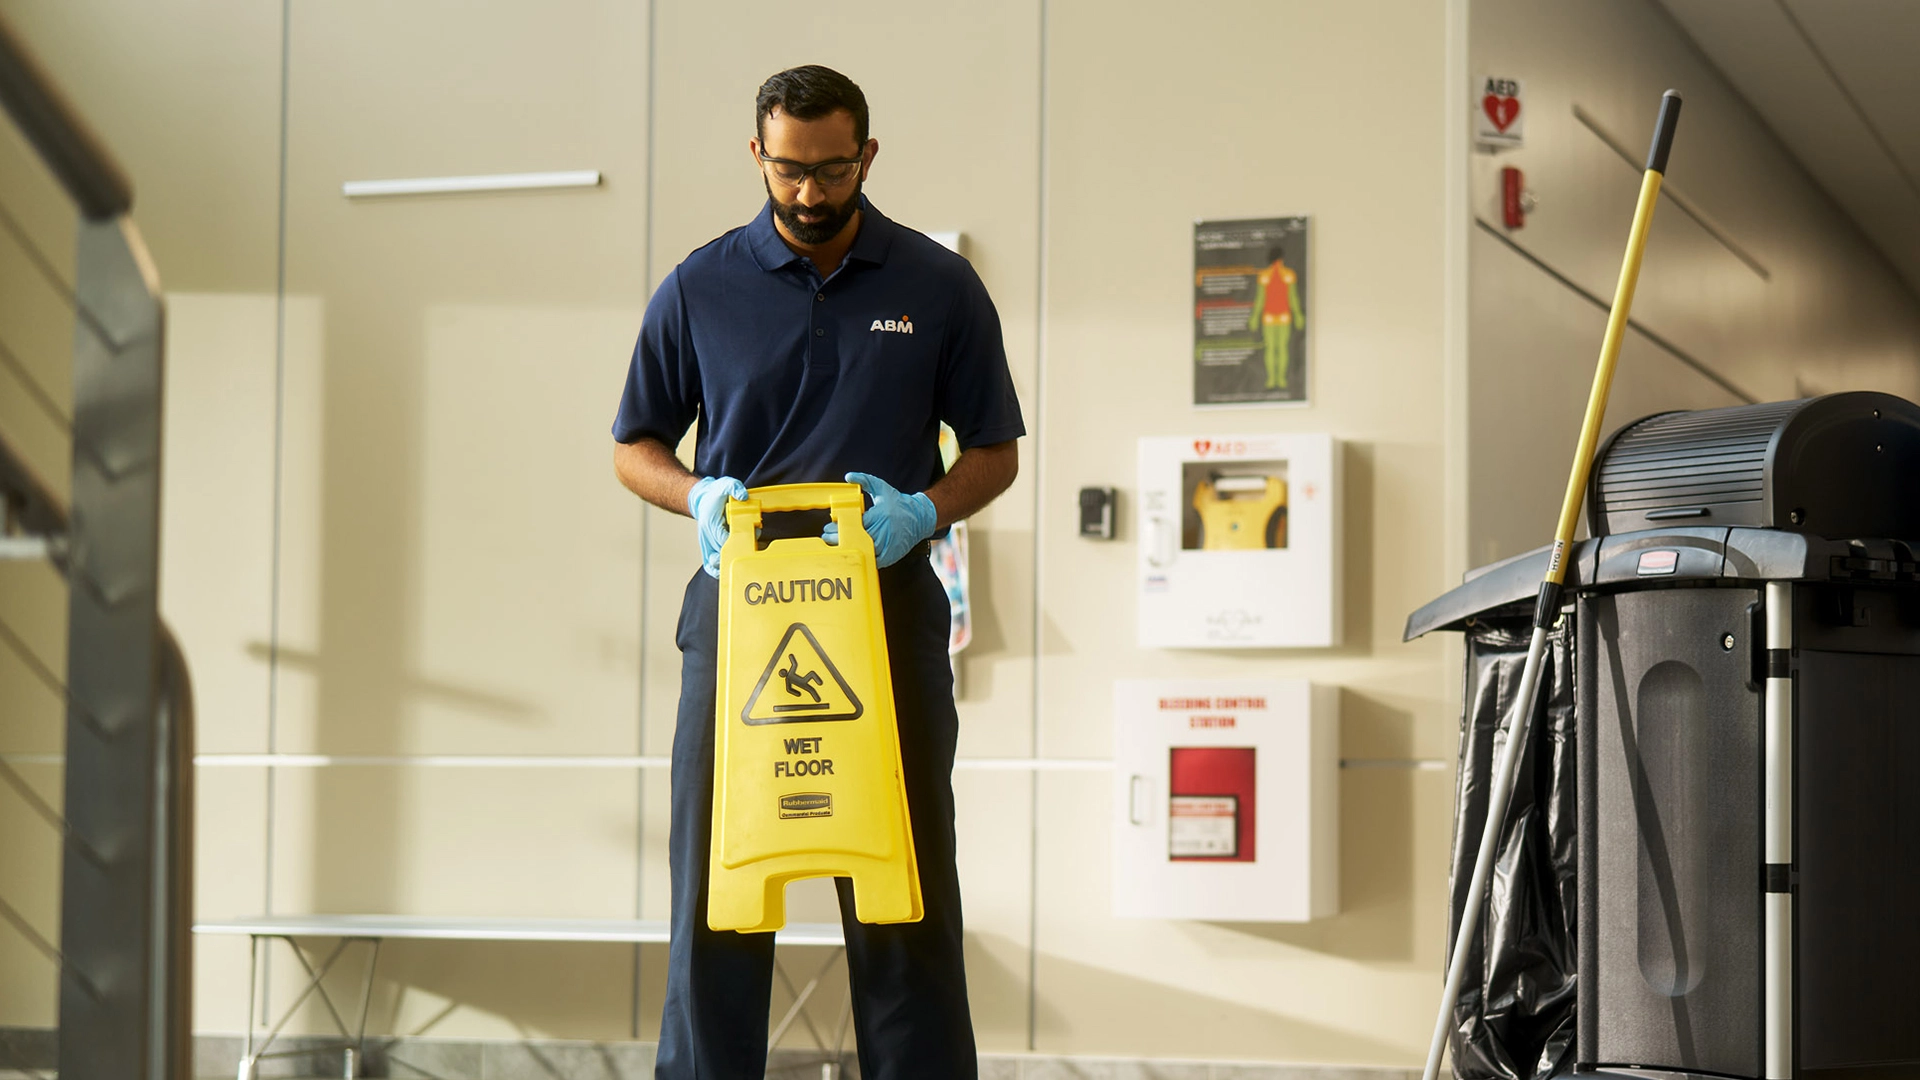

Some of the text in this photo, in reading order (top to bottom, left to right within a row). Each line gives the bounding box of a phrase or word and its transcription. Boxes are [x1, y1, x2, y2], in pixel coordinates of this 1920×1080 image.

[1482, 79, 1519, 96] AED
[870, 317, 913, 334] ABM
[744, 577, 852, 605] CAUTION
[783, 737, 822, 755] WET
[774, 760, 834, 778] FLOOR
[783, 799, 828, 807] Rubbermaid
